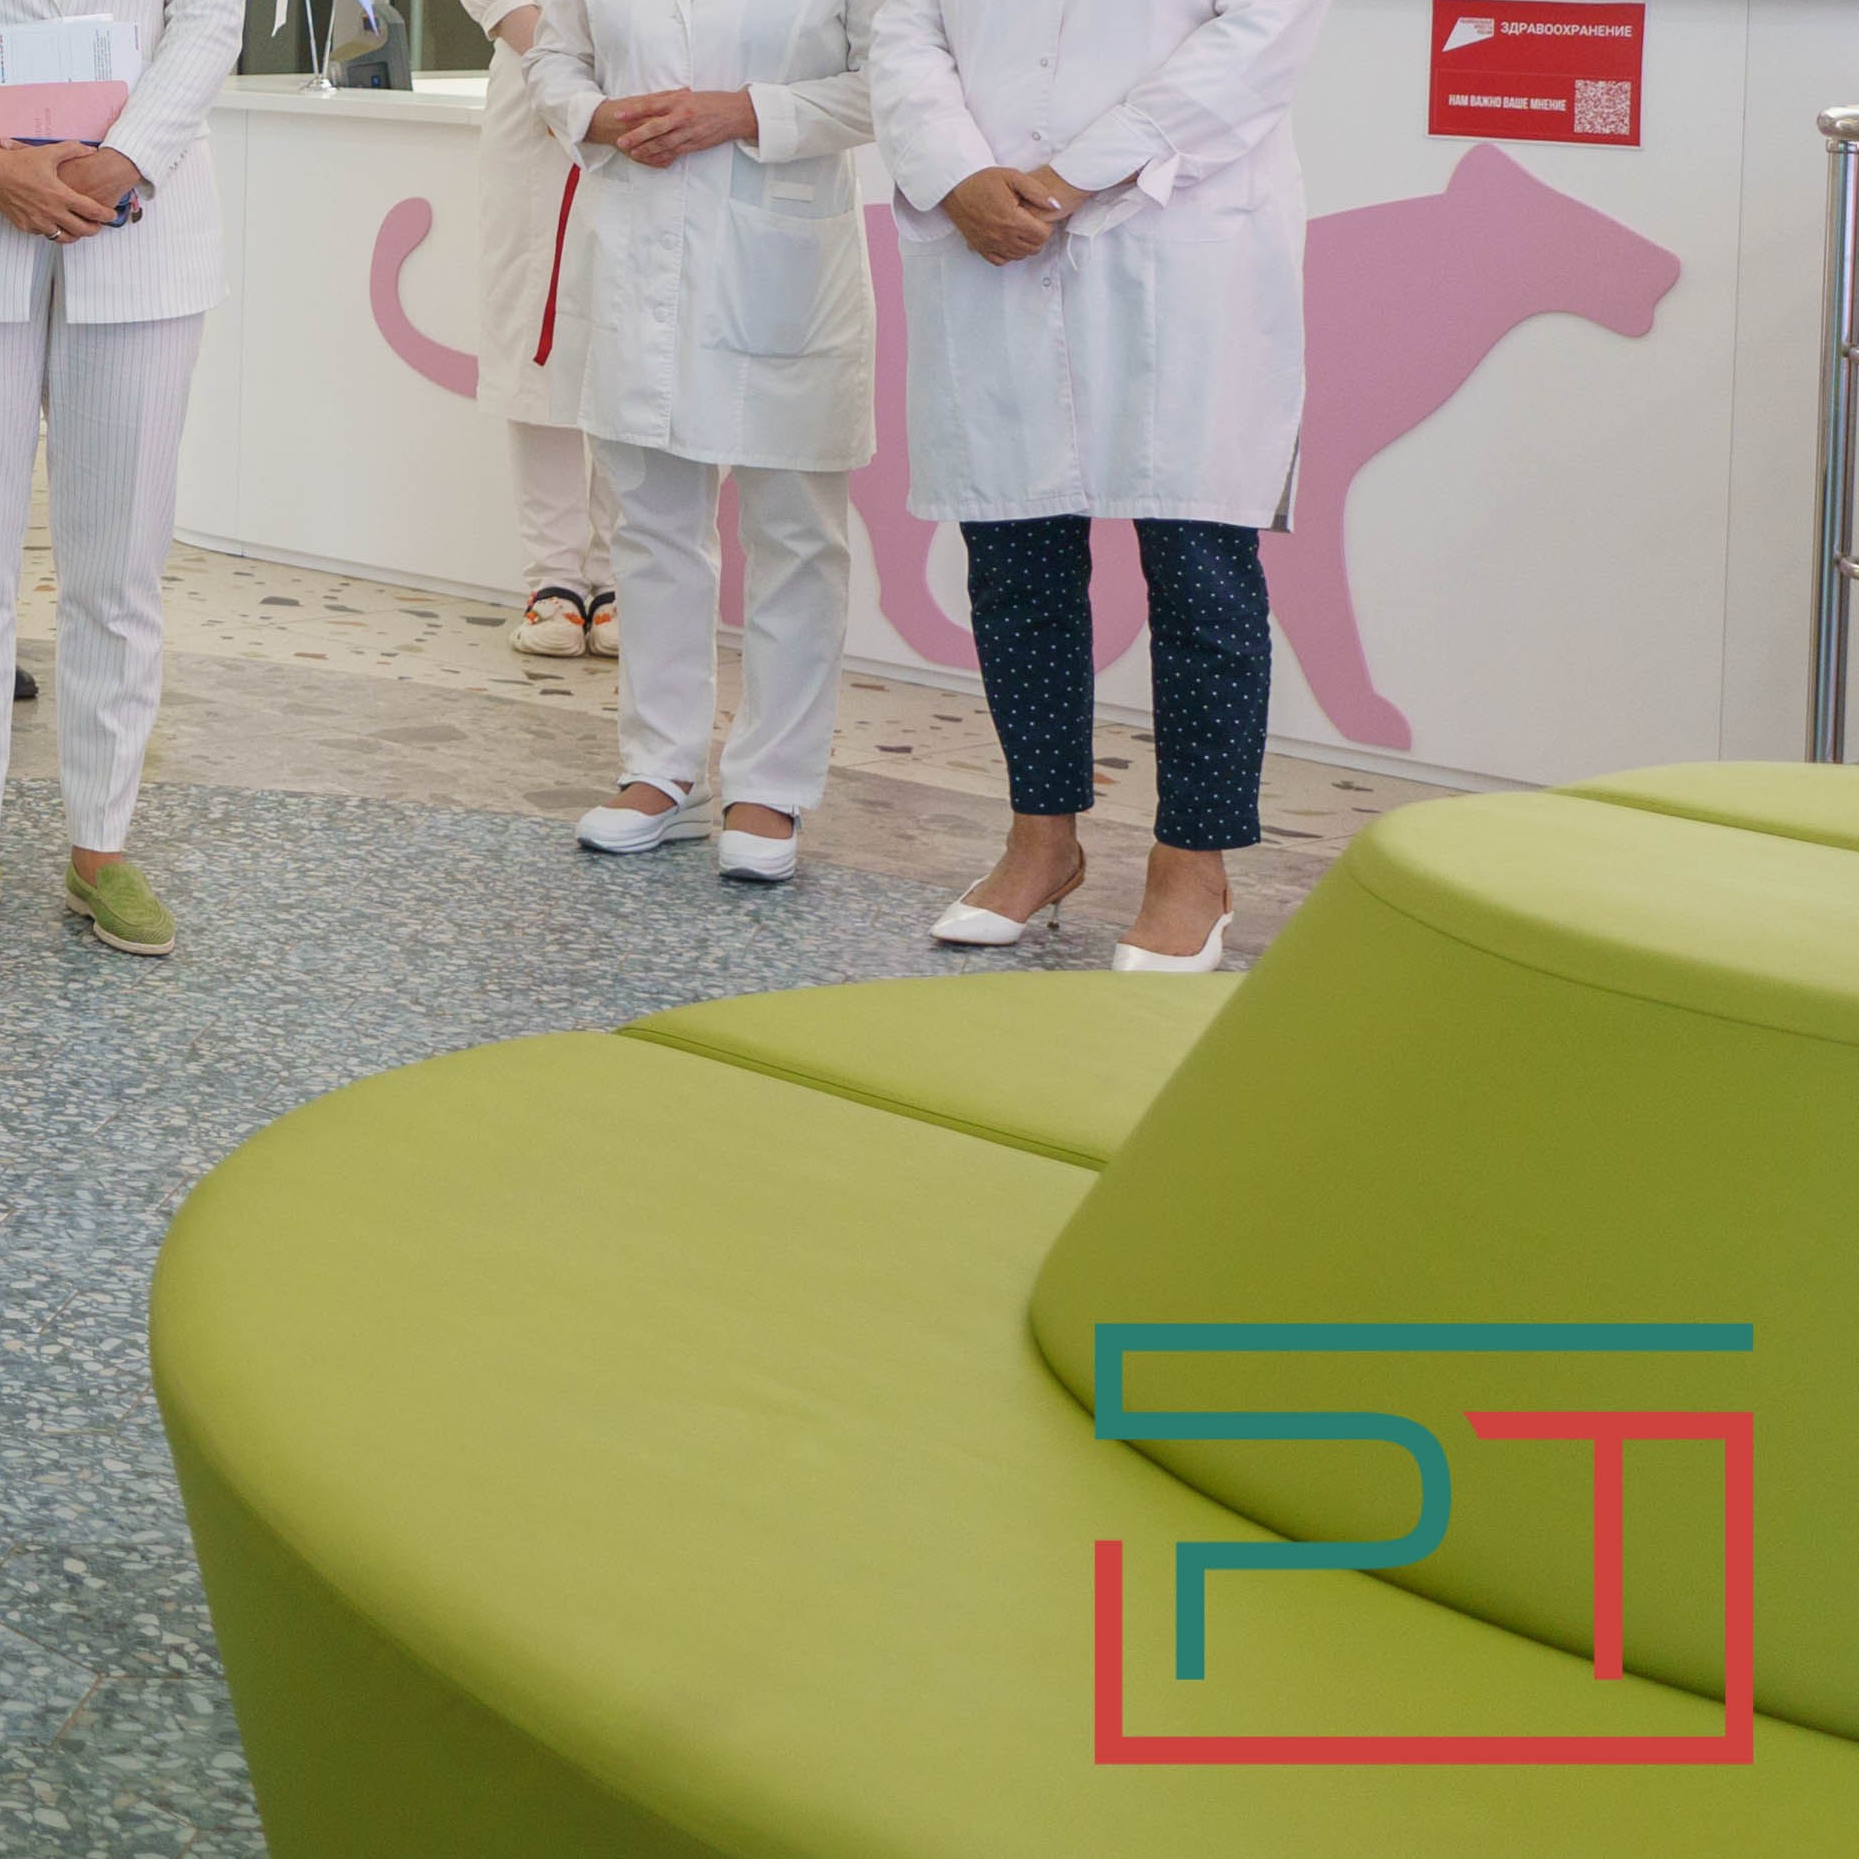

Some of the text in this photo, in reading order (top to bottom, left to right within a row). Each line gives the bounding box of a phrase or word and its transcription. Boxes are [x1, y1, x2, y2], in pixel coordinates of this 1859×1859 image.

[1499, 21, 1633, 38] ЗДРАВООХРАНЕНИЕ
[1448, 94, 1567, 112] НАМ ВАЖНО ВАШЕ МНЕНИЕ
